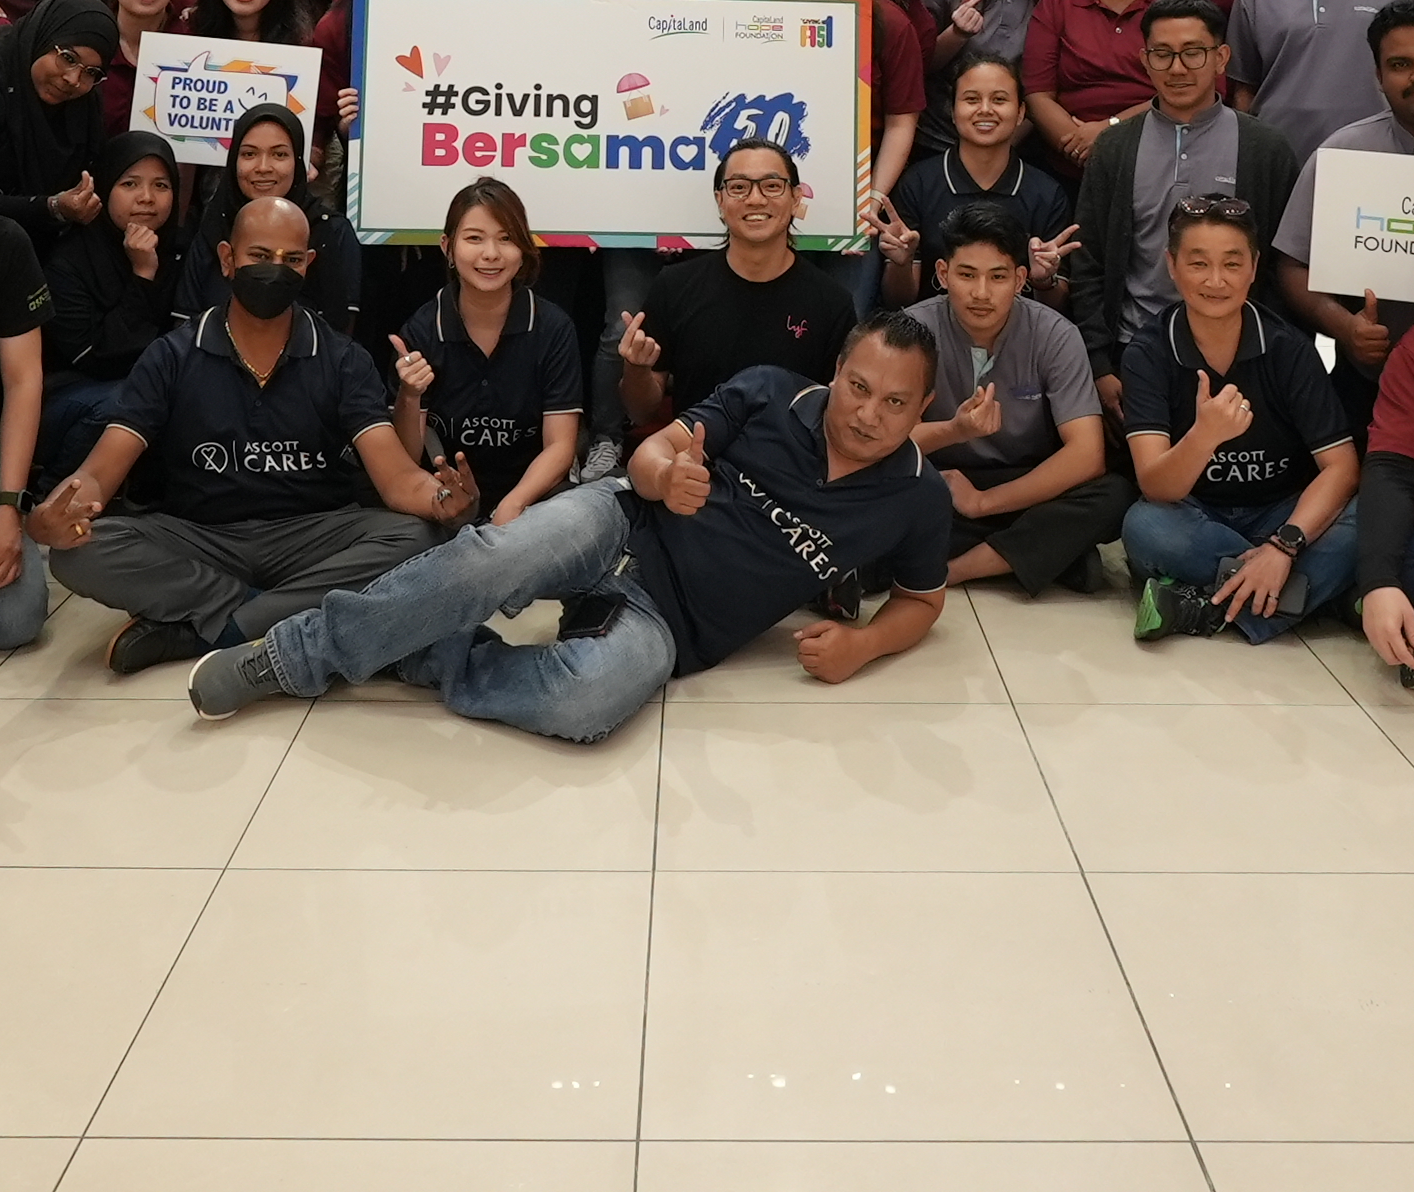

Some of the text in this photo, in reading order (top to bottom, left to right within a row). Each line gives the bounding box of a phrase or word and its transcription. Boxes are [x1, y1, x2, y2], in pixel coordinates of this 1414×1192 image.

[648, 14, 708, 33] CapitaLand
[735, 31, 784, 41] FOUNDATION
[171, 76, 229, 94] PROUD
[170, 94, 235, 114] TO BE A
[422, 83, 599, 129] #Giving
[167, 112, 233, 132] VOLUNT
[422, 123, 706, 170] Bersama
[787, 315, 808, 339] lyf
[460, 417, 517, 430] ASCOTT
[459, 425, 538, 447] CARES
[243, 441, 300, 453] ASCOTT
[1207, 450, 1266, 463] ASCOTT
[243, 453, 328, 473] CARES
[1206, 458, 1290, 483] CARES
[770, 506, 838, 581] CARES
